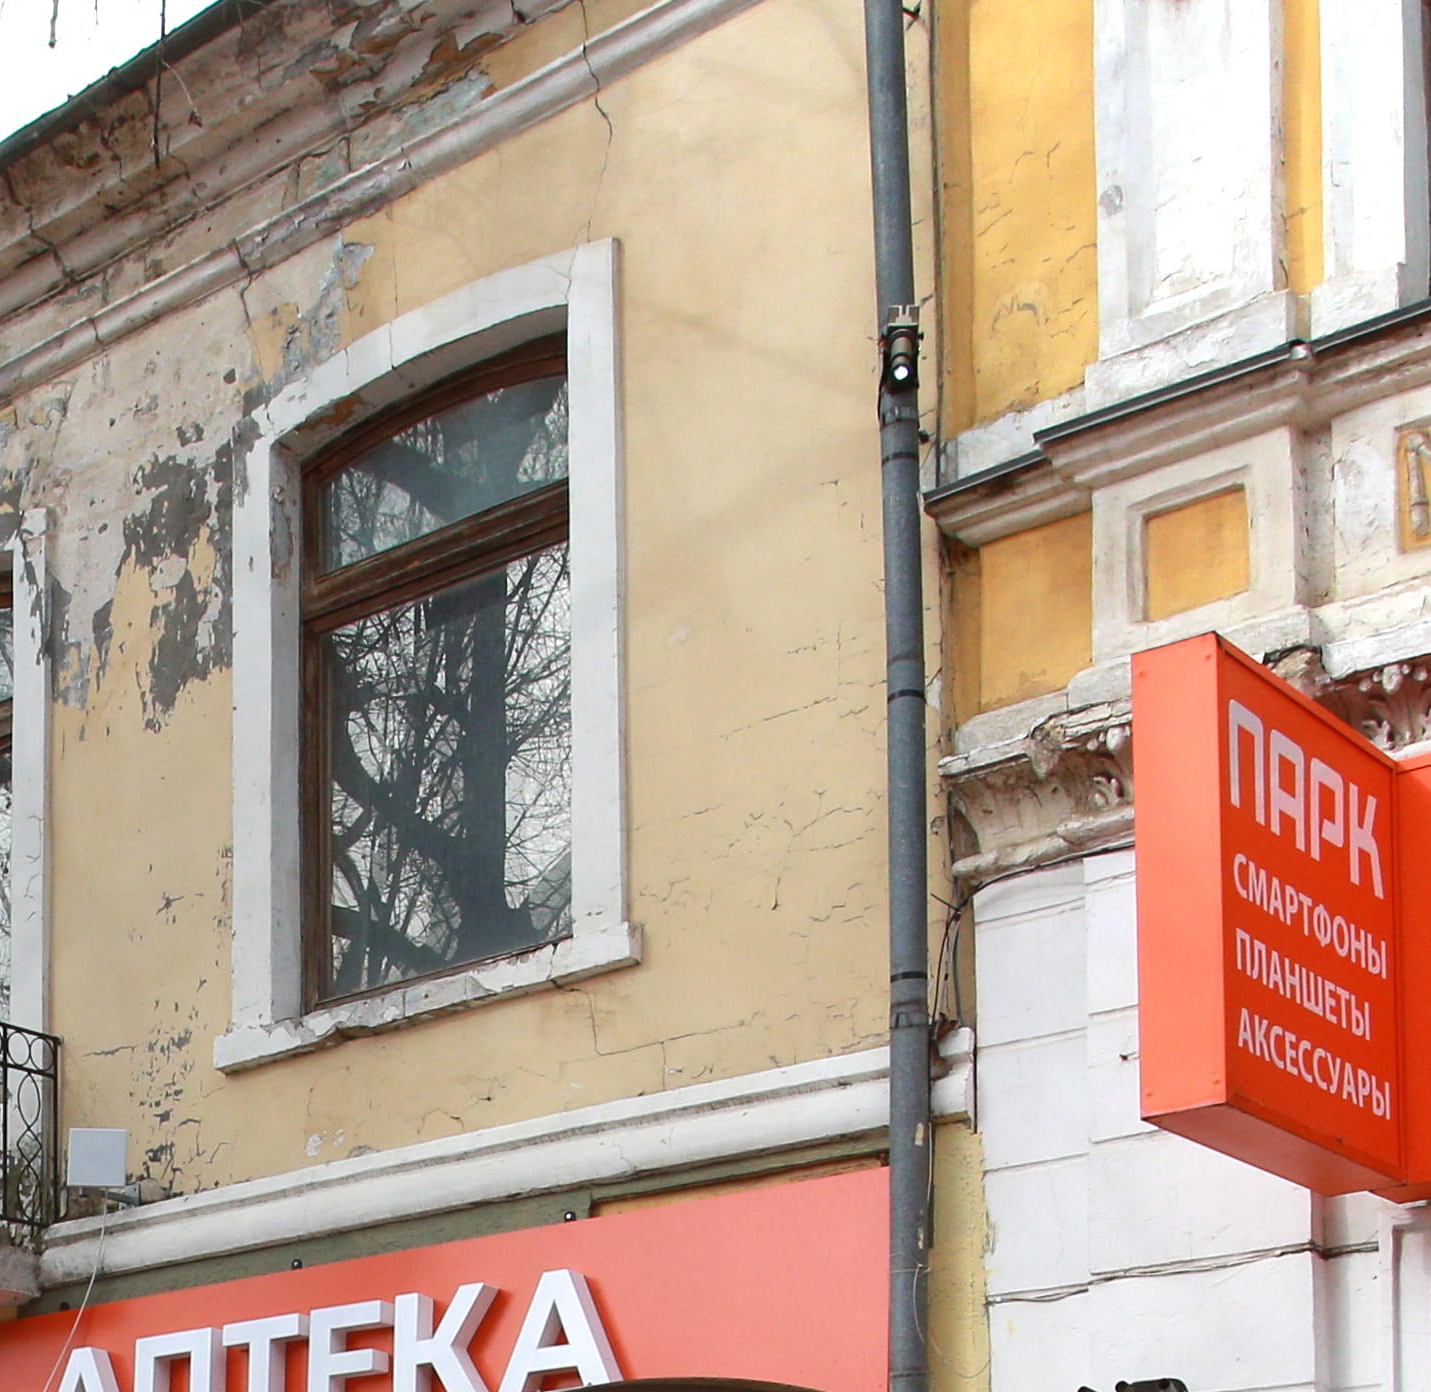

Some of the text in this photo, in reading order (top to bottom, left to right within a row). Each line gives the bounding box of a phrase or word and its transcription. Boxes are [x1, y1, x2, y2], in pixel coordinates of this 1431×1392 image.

[1227, 697, 1385, 899] ПАРК
[1233, 852, 1388, 980] СМАРТФОНЫ
[1235, 927, 1371, 1041] ПЛАНШЕТЫ
[1238, 1007, 1391, 1121] АКСЕССУАРЫ
